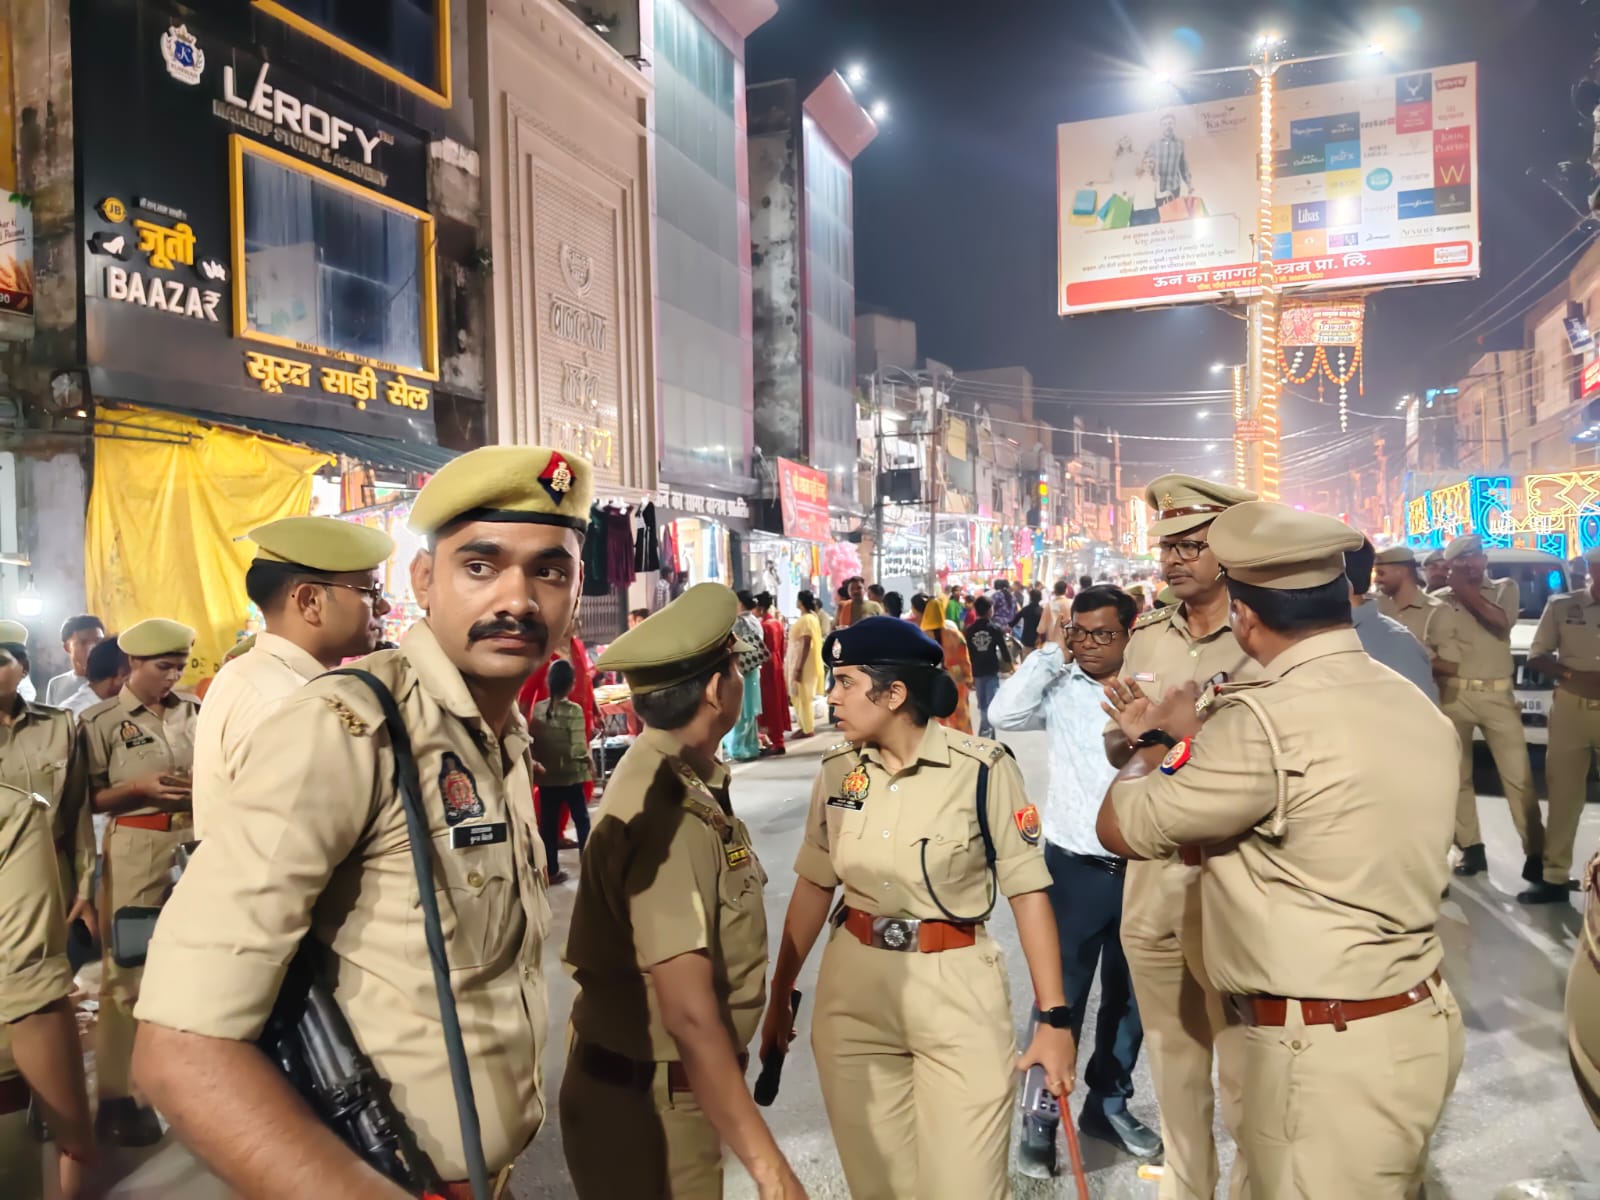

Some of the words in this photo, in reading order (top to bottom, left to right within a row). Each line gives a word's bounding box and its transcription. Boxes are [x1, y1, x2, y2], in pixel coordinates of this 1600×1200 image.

[223, 62, 380, 164] LEROFY
[212, 99, 273, 138] MAKEUP
[273, 129, 321, 159] STUDIO
[332, 152, 389, 188] ACADEMY
[1439, 163, 1466, 185] W
[1297, 207, 1321, 224] Libas
[133, 218, 197, 270] जूती
[1153, 273, 1183, 288] ऊन
[1186, 269, 1210, 284] का
[1213, 265, 1258, 281] सागर
[1272, 258, 1312, 276] स्त्रम्
[1341, 251, 1373, 268] लि.
[296, 341, 319, 354] MAHA
[353, 354, 371, 367] SALE
[376, 359, 398, 372] OFFER
[246, 351, 313, 394] सूरत
[320, 365, 379, 411] साड़ी
[386, 375, 431, 412] सेल
